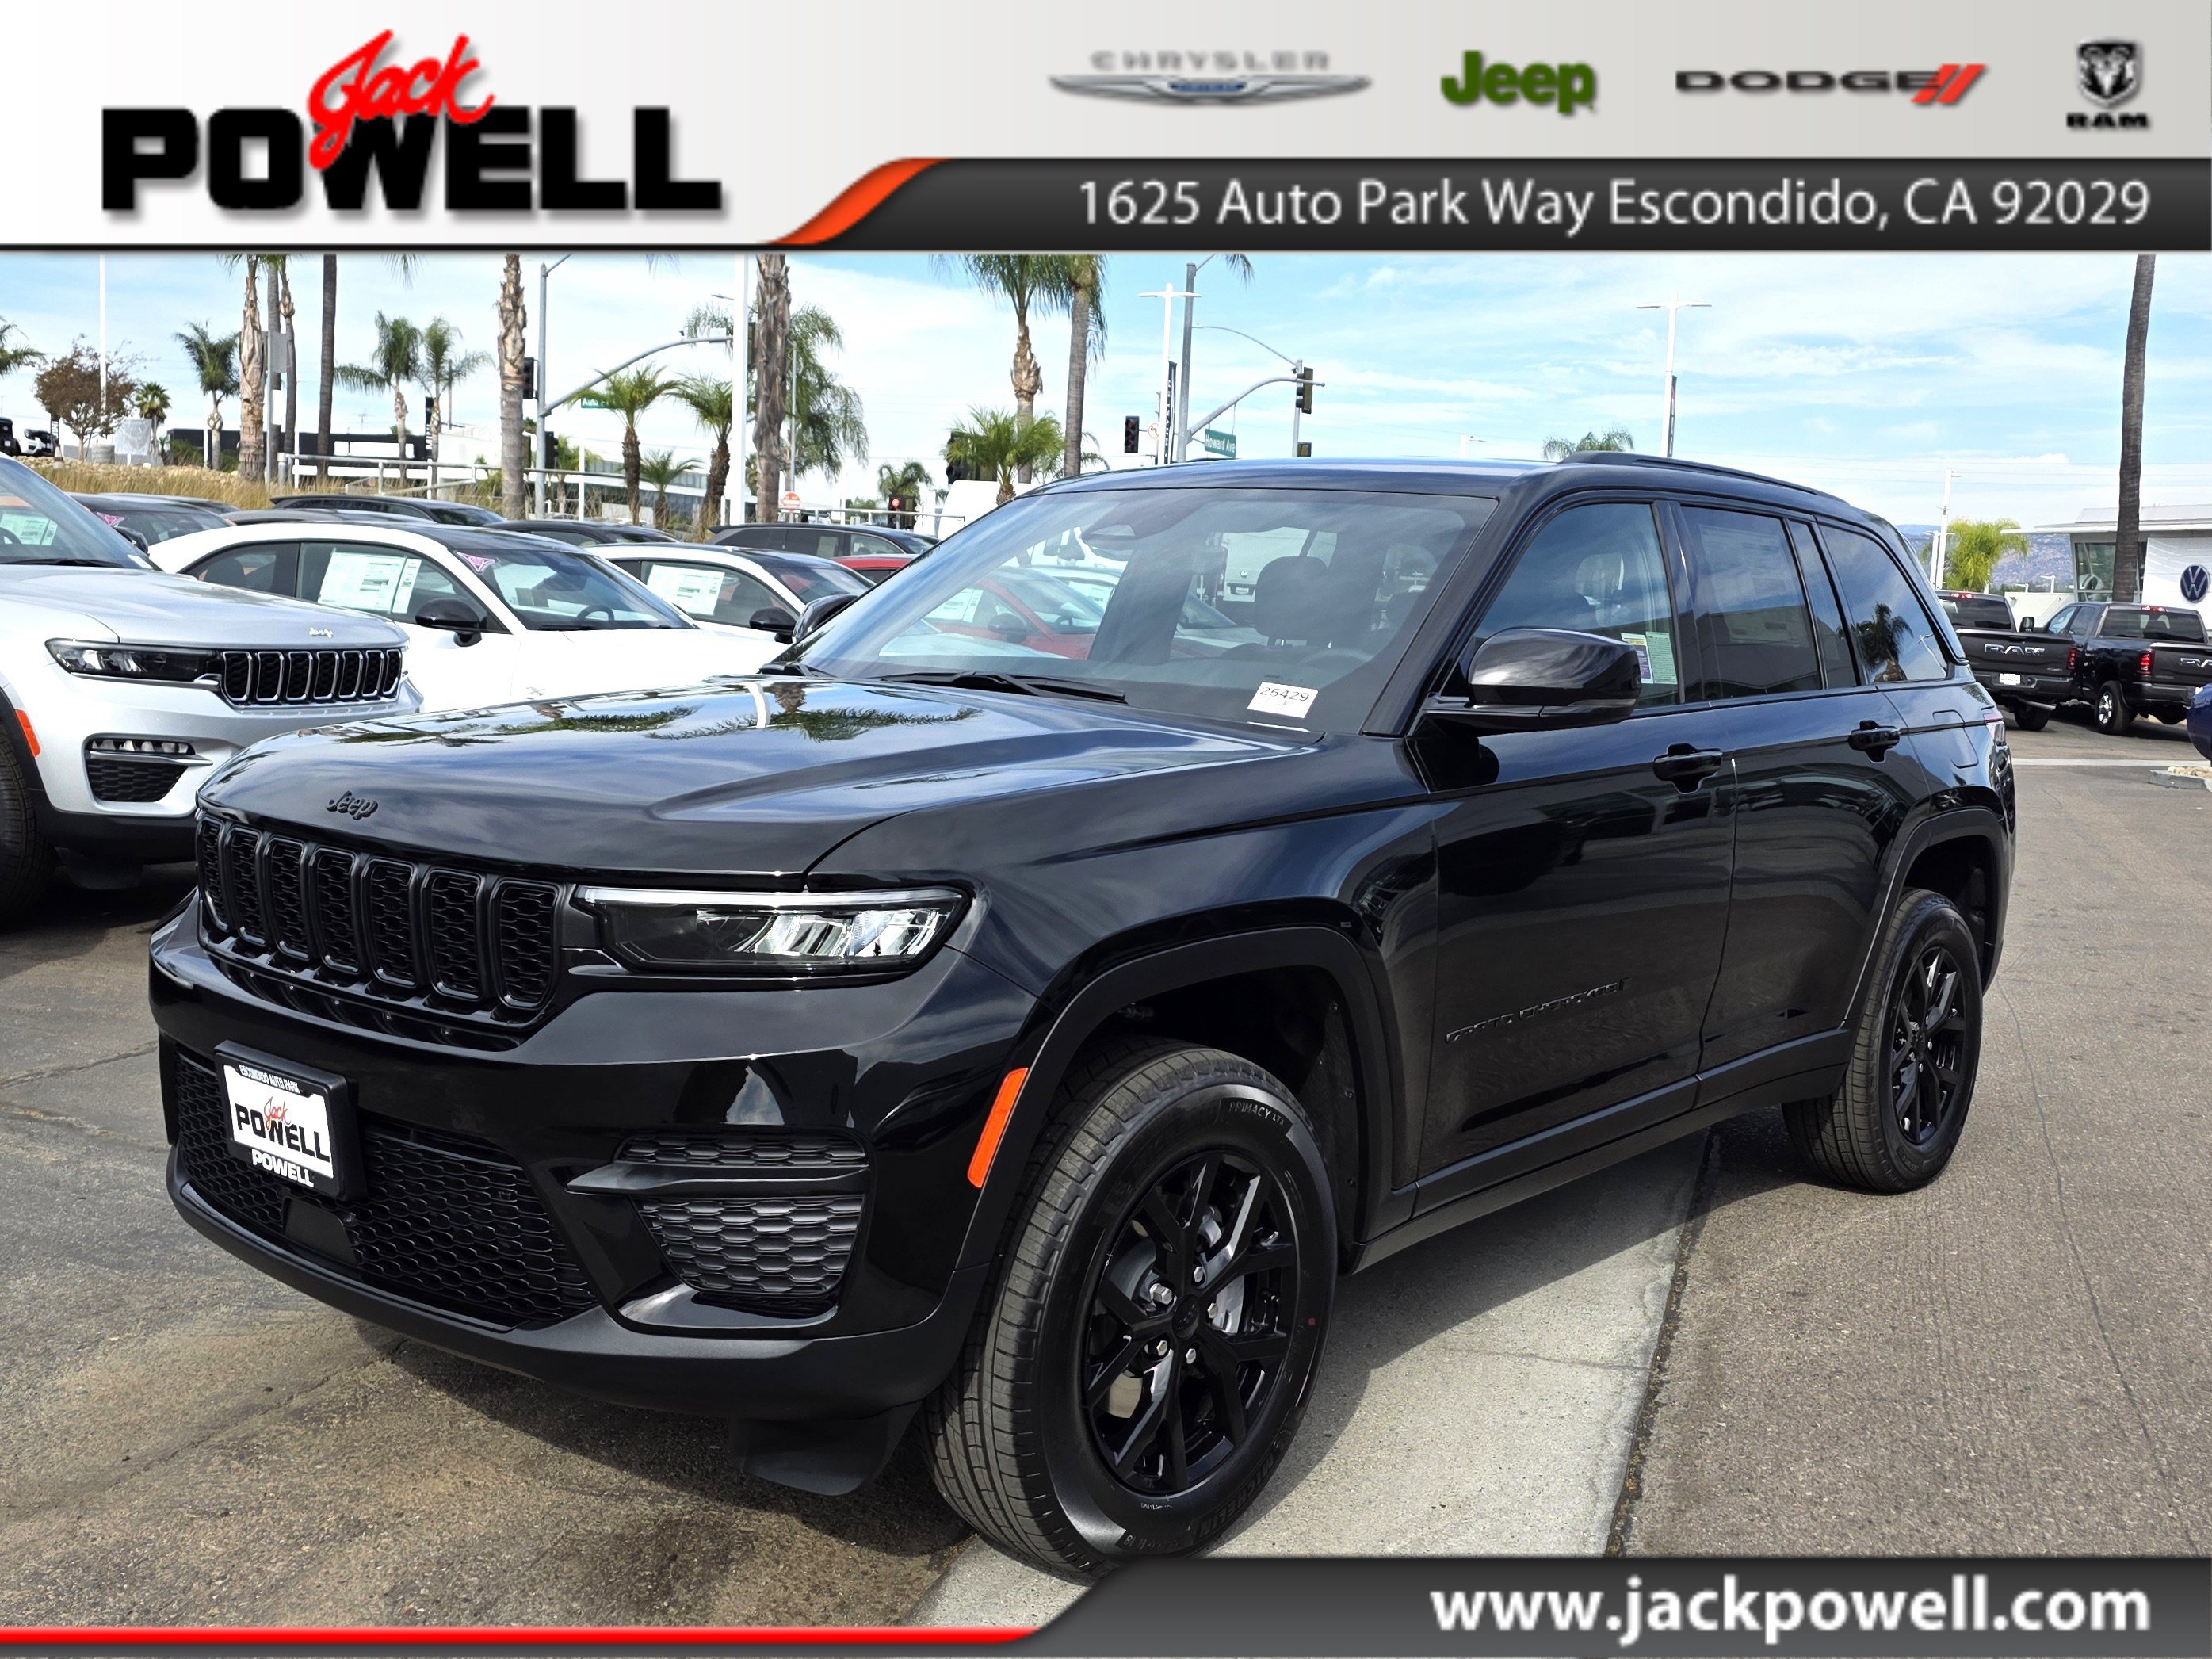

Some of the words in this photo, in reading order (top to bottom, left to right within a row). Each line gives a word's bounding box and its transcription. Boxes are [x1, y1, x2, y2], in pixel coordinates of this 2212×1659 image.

[1205, 434, 1225, 451] Howard
[1225, 438, 1236, 453] Ave
[1259, 686, 1309, 701] 25429
[326, 790, 379, 820] Jeep
[239, 1064, 269, 1084] ESCONDIDO
[269, 1074, 285, 1090] AUTO
[283, 1078, 301, 1094] PARK
[263, 1096, 292, 1130] Jack
[1228, 1100, 1272, 1120] PRIMACY
[235, 1103, 331, 1164] POWELL
[251, 1148, 315, 1188] POWELL
